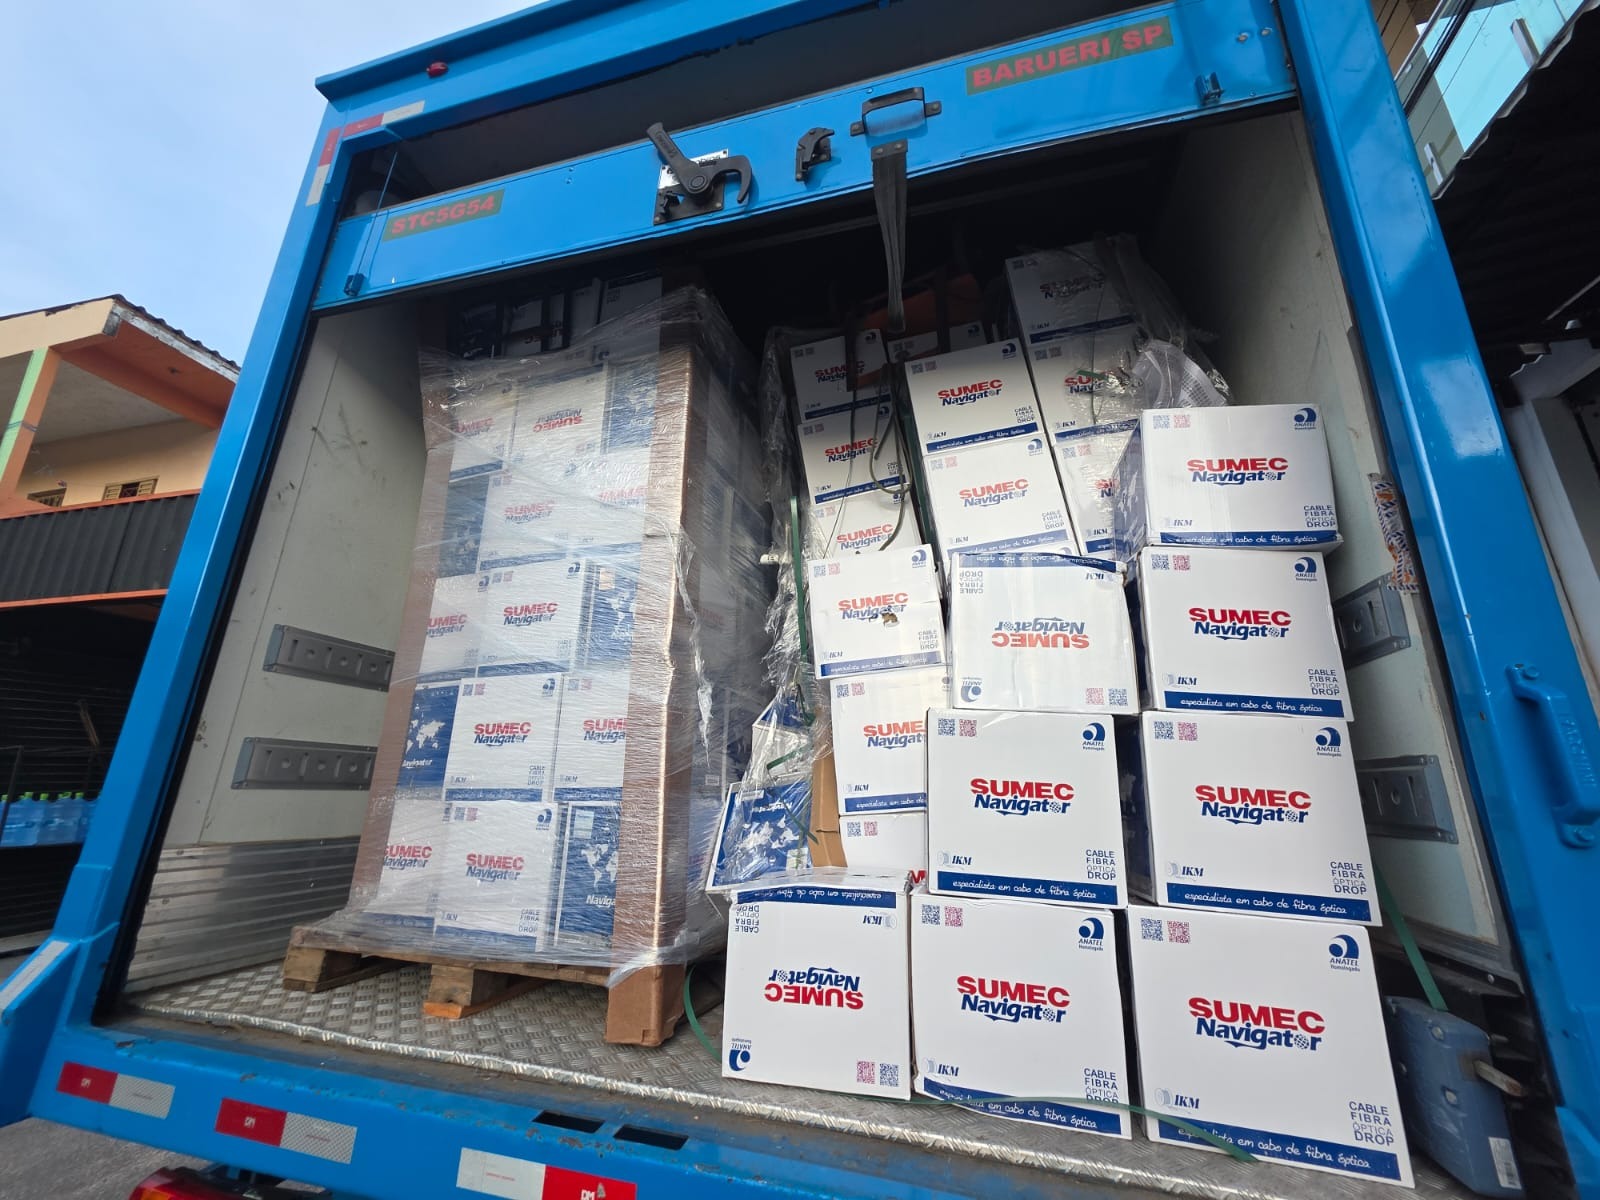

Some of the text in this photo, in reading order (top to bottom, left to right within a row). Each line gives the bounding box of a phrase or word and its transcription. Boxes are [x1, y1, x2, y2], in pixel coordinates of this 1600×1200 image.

[972, 24, 1164, 88] BARUERI SP
[391, 195, 495, 234] STC5G54
[815, 360, 865, 378] SUMC
[938, 379, 1004, 400] SUMEC
[942, 386, 1003, 406] Navigator
[825, 437, 878, 457] SUMEC
[1187, 457, 1289, 472] SUMEC
[1192, 468, 1288, 485] Navigator
[959, 478, 1029, 500] SUMEC
[964, 487, 1028, 508] Navigator
[1173, 519, 1193, 527] IKM
[836, 523, 894, 543] SUMEC
[1093, 528, 1108, 536] IKM
[838, 592, 909, 611] SUMEC
[503, 602, 559, 617] SUMEC
[1188, 607, 1292, 626] SUMEC
[428, 614, 468, 627] UMEC
[503, 612, 556, 628] Navigator
[994, 617, 1085, 635] Navigator
[1194, 621, 1289, 641] Navigator
[991, 632, 1090, 649] SUMEC
[1308, 668, 1337, 676] CABLE
[1309, 675, 1338, 683] FIBRA
[1177, 676, 1197, 686] IKM
[1311, 687, 1340, 696] DROP
[1180, 699, 1223, 709] especialista
[1241, 700, 1259, 709] cabo
[1261, 702, 1272, 710] de
[1276, 701, 1296, 712] fibra
[1299, 703, 1323, 713] óptica
[474, 721, 532, 735] SUMEC
[863, 720, 925, 738] SUME
[473, 733, 529, 747] Navigator
[584, 729, 626, 744] Naviga
[867, 733, 924, 750] Navigat
[970, 778, 1074, 800] SUMEC
[1195, 784, 1312, 810] SUMEC
[974, 794, 1070, 816] Navigator
[1201, 801, 1309, 825] Navigator
[465, 852, 525, 871] SUMEC
[952, 855, 972, 866] IKM
[1085, 849, 1115, 859] CABLE
[1086, 857, 1116, 867] FIBRA
[1330, 861, 1364, 871] CABLE
[465, 865, 520, 882] Navigator
[1087, 871, 1117, 881] DROP
[1182, 866, 1204, 877] IKM
[1331, 869, 1366, 879] FIBRA
[952, 880, 996, 891] especialista
[1014, 883, 1032, 894] cabo
[1035, 885, 1046, 895] de
[1049, 885, 1070, 897] fibra
[1073, 888, 1096, 899] óptica
[1332, 877, 1367, 887] ÓPTICA
[808, 890, 825, 899] cabo
[842, 891, 882, 900] especialista
[1334, 884, 1368, 896] DROP
[1184, 892, 1347, 914] especialista em cabo de fibra óptica
[735, 918, 760, 926] FIBRA
[863, 915, 883, 926] IKM
[735, 925, 760, 933] CABLE
[1078, 938, 1103, 946] ANATEL
[1330, 957, 1359, 966] ANATEL
[769, 967, 861, 992] Navigator
[764, 983, 864, 1010] SUMEC
[957, 976, 1070, 1008] SUMEC
[961, 994, 1066, 1023] Navigator
[1188, 997, 1325, 1034] SUMEC
[1196, 1016, 1322, 1050] Navigator
[938, 1064, 959, 1077] IKM
[1084, 1068, 1117, 1081] CABLE
[1084, 1077, 1118, 1090] FIBRA
[1085, 1086, 1119, 1099] ÓPTICA
[1174, 1094, 1200, 1109] IKM
[1349, 1101, 1389, 1116] CABLE
[988, 1102, 1098, 1129] em cabo de fibra óptica
[1350, 1111, 1392, 1127] FIBRA
[1352, 1122, 1394, 1136] ÓPTICA
[1354, 1131, 1395, 1146] DROP
[1238, 1138, 1371, 1168] em cabo de fibra óptica
